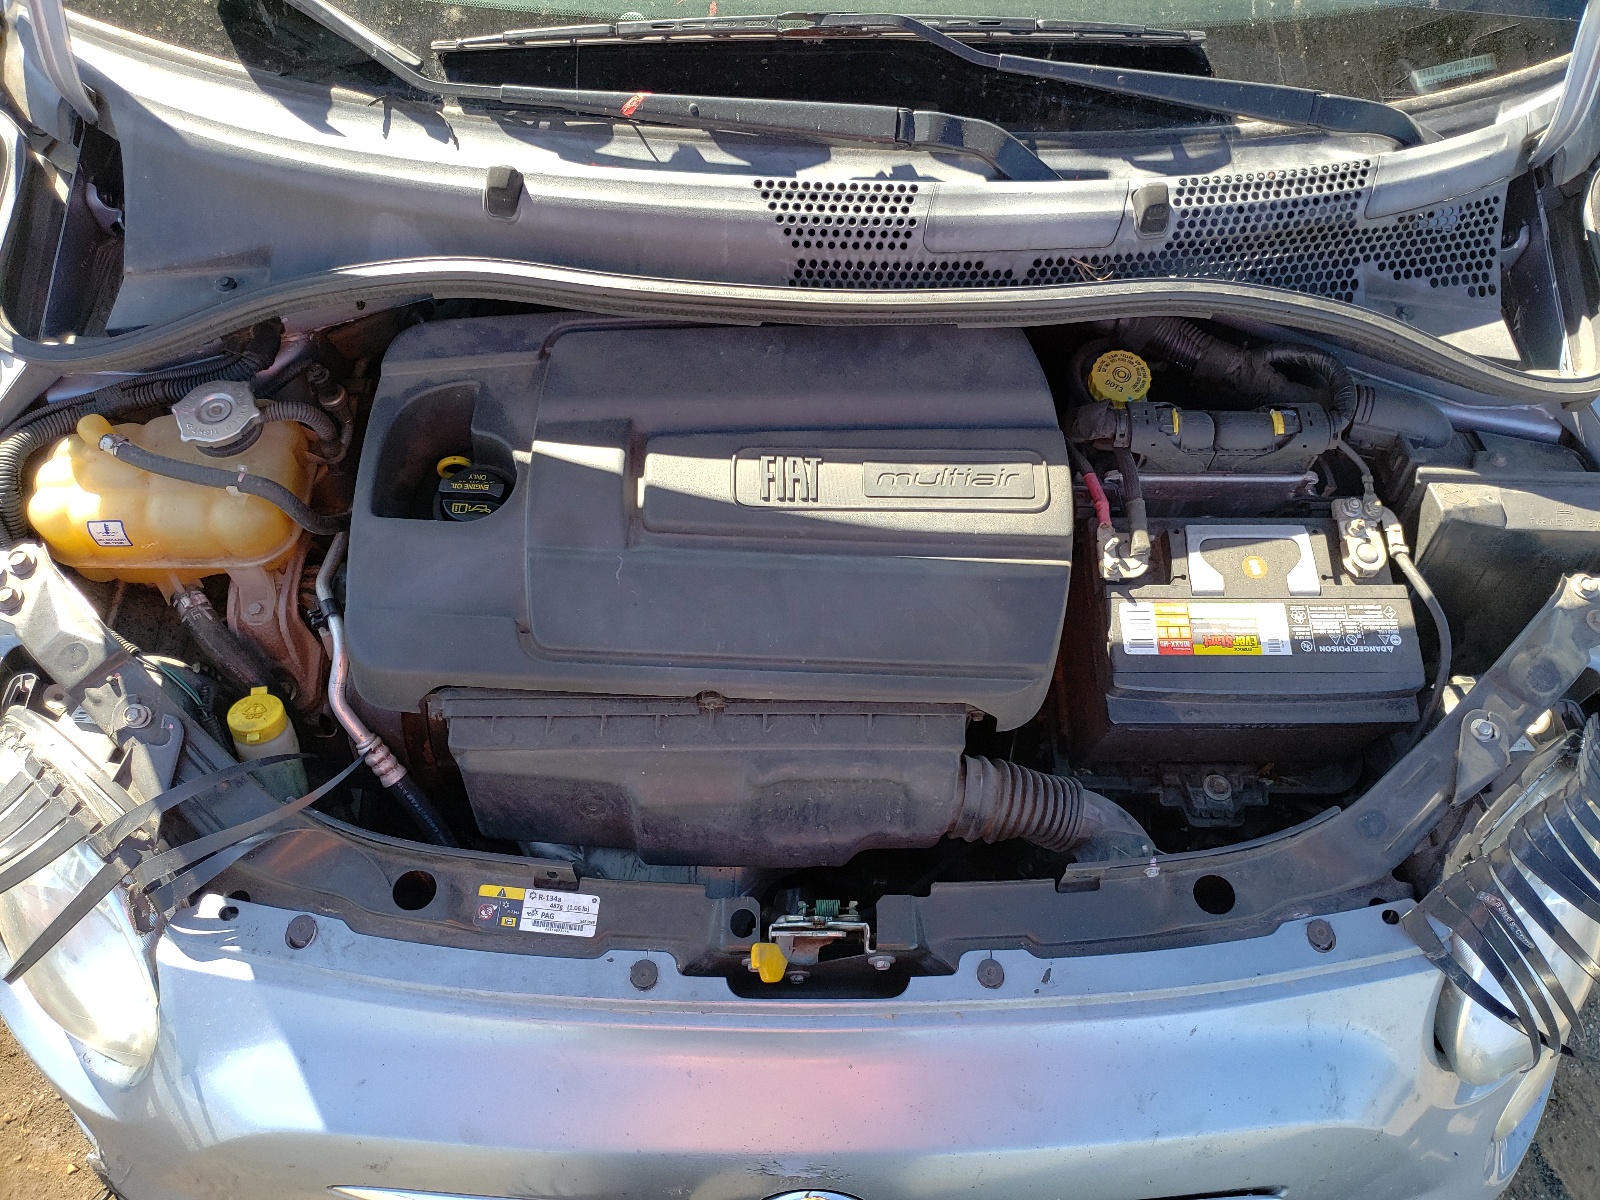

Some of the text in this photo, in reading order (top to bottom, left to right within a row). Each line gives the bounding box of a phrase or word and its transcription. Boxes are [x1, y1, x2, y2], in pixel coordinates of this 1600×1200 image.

[759, 455, 822, 502] FIAT
[876, 467, 1021, 488] multiair
[464, 483, 489, 491] ENGINE
[1319, 645, 1387, 653] DANGER/POISON
[538, 894, 562, 903] R-134a
[540, 911, 555, 920] PAG
